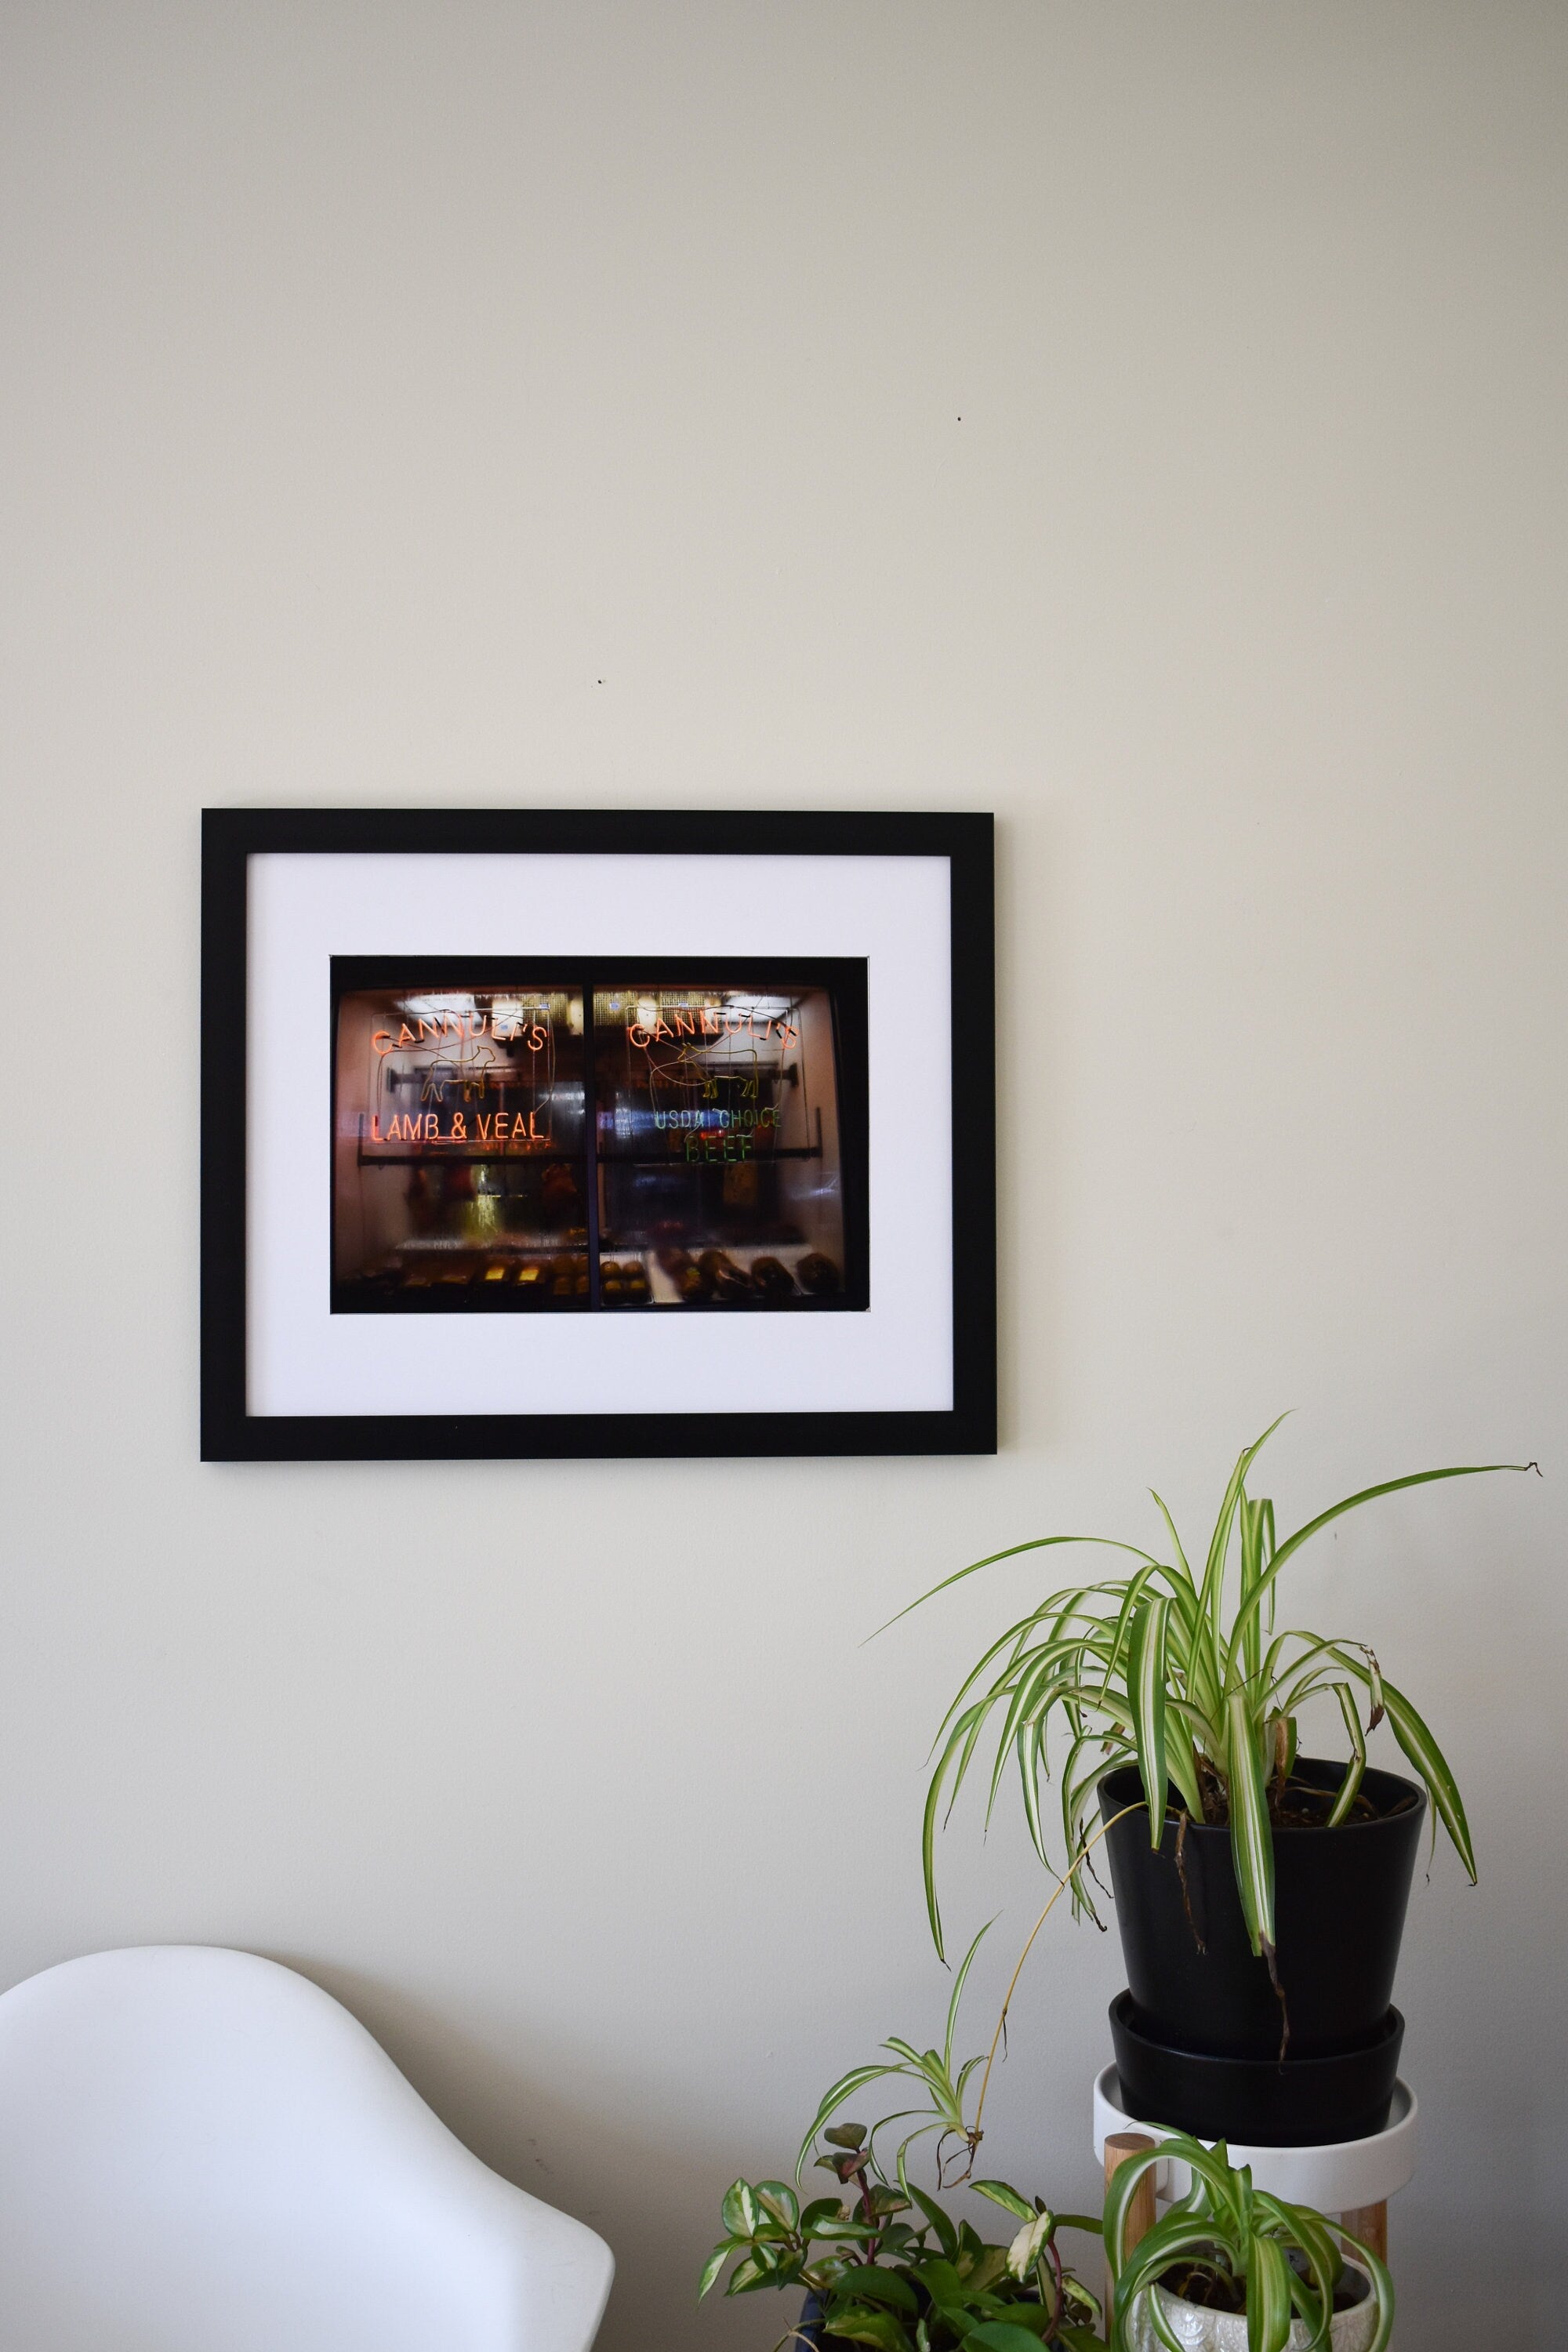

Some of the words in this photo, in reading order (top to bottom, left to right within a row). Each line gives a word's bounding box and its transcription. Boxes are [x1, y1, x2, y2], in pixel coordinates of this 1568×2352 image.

[371, 1010, 548, 1055] CANNULI'S
[372, 1112, 439, 1142] LAMB
[451, 1112, 467, 1140] &
[477, 1111, 545, 1140] VEAL
[655, 1109, 705, 1130] USDA
[719, 1109, 782, 1129] CHOICE
[685, 1135, 753, 1163] BEEF
